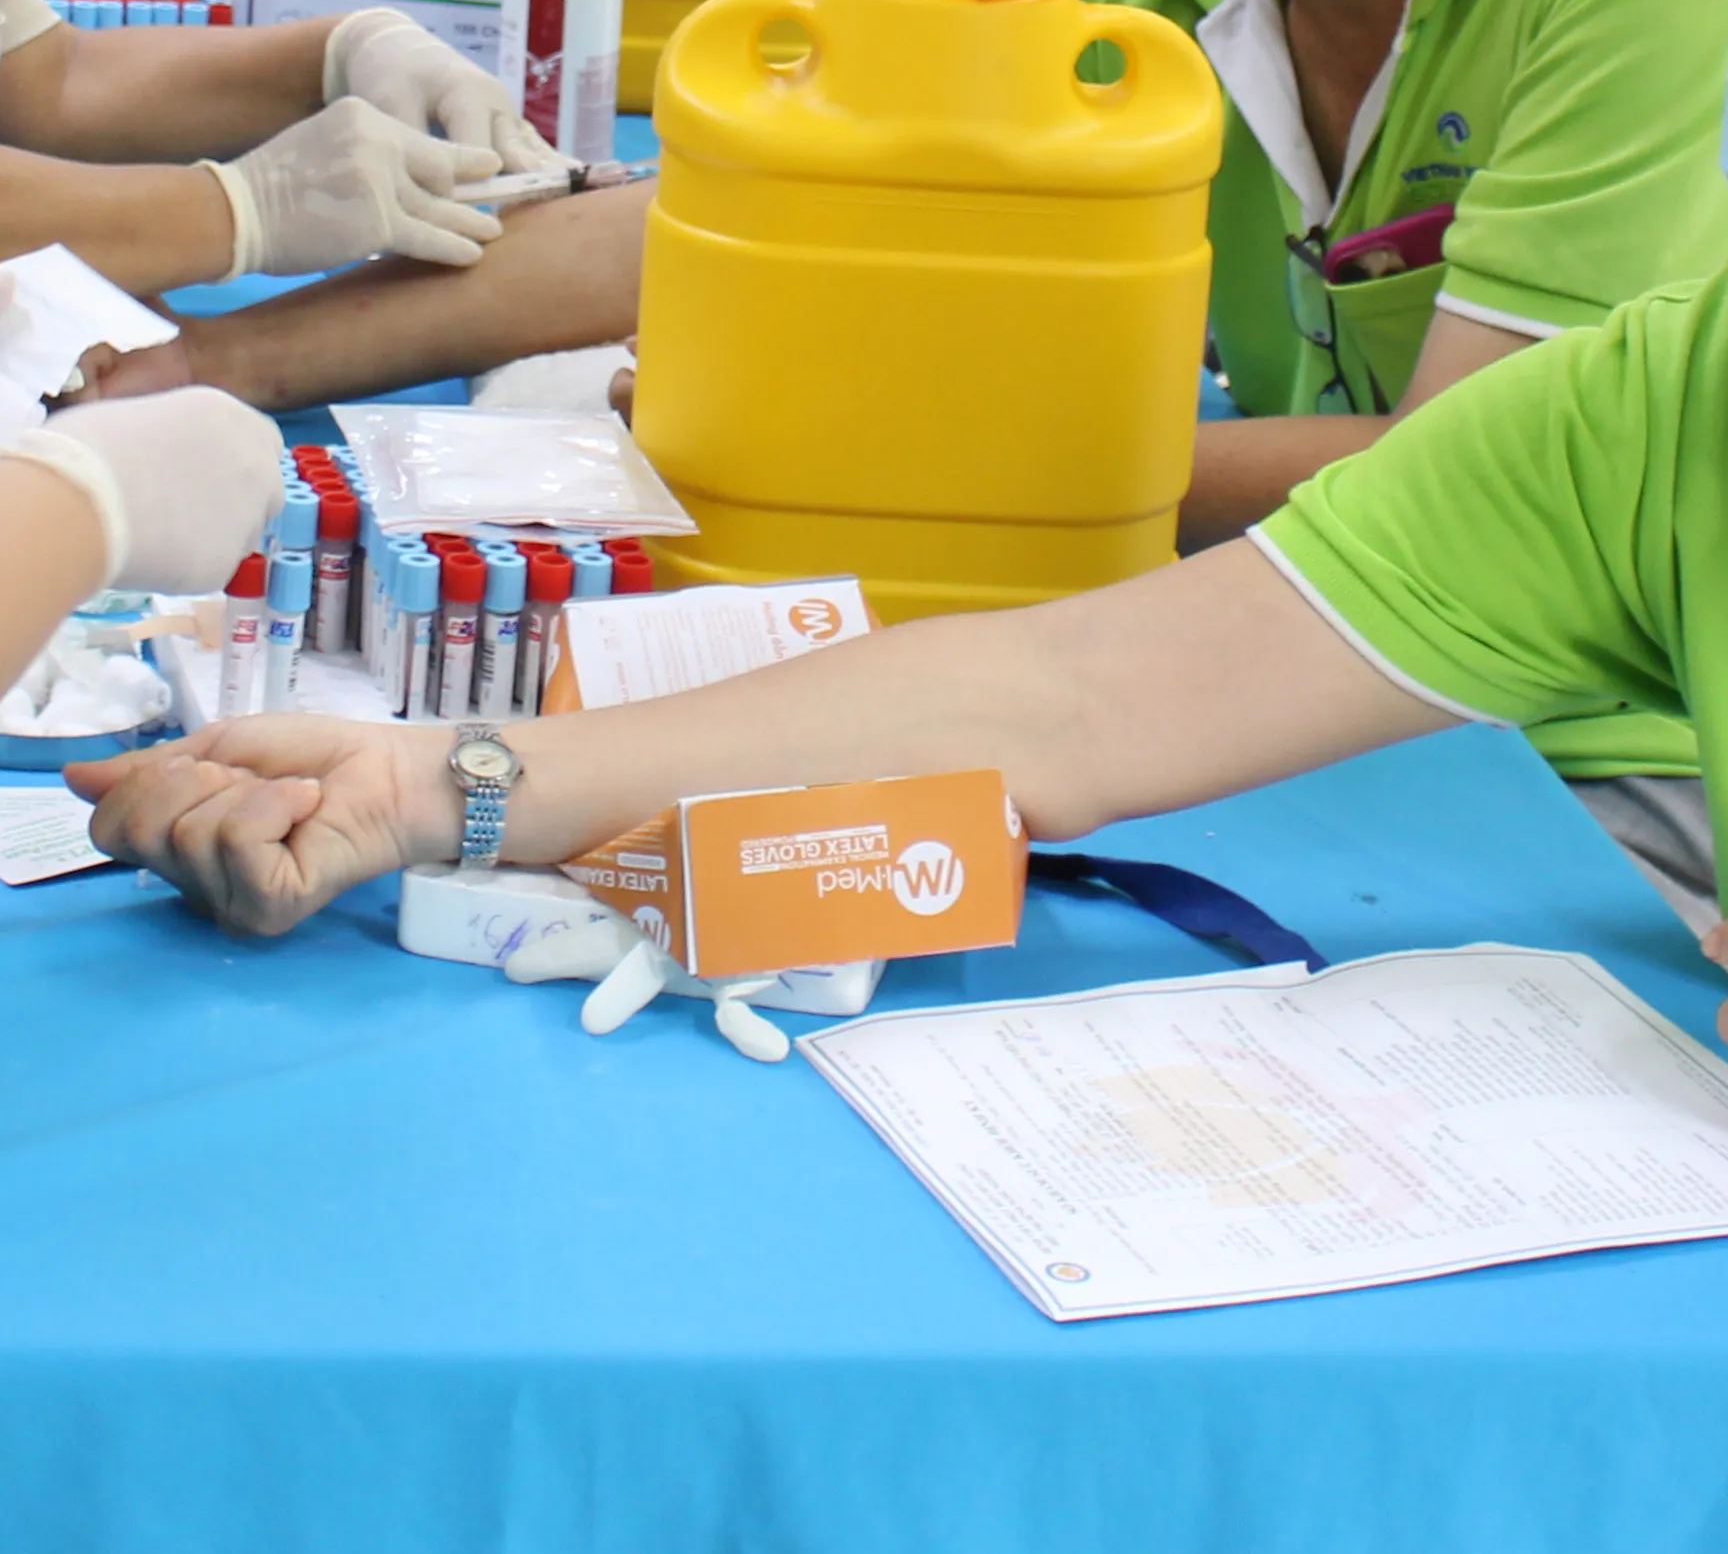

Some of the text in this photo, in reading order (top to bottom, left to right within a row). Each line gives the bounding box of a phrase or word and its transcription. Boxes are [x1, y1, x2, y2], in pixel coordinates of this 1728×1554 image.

[739, 833, 889, 866] LATEX GLOVES
[618, 872, 668, 894] LATEX
